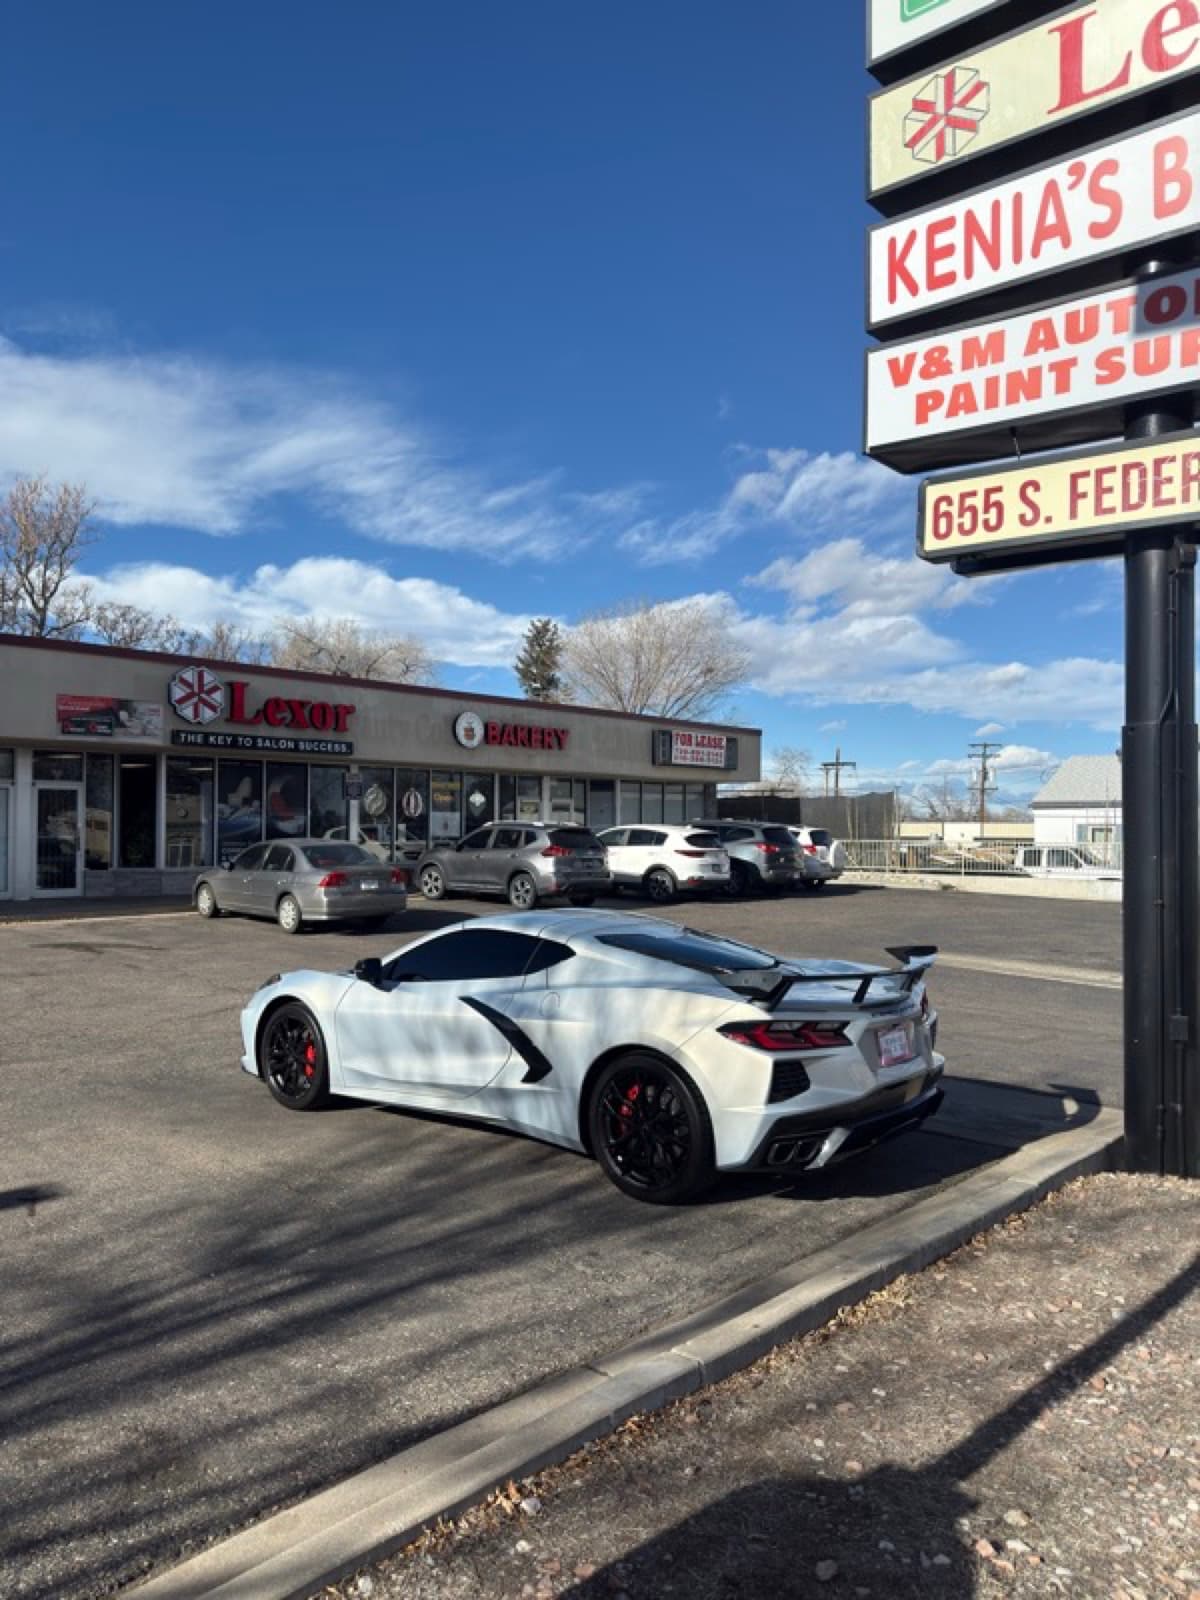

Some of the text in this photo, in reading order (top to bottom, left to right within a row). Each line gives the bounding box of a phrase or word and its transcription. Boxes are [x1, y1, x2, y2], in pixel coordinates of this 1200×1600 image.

[1047, 0, 1200, 114] Le
[887, 135, 1193, 305] KENIA'S B
[886, 278, 1200, 388] V&M AUTO
[915, 357, 1078, 425] PAINT
[932, 484, 1004, 541] 655
[1018, 478, 1053, 527] S.
[225, 681, 357, 733] Lexor
[485, 721, 570, 751] BAKERY
[179, 733, 203, 744] THE
[209, 735, 233, 746] KEY
[237, 737, 252, 747] TO
[256, 738, 295, 750] SALON
[673, 731, 725, 750] FOR LEASE
